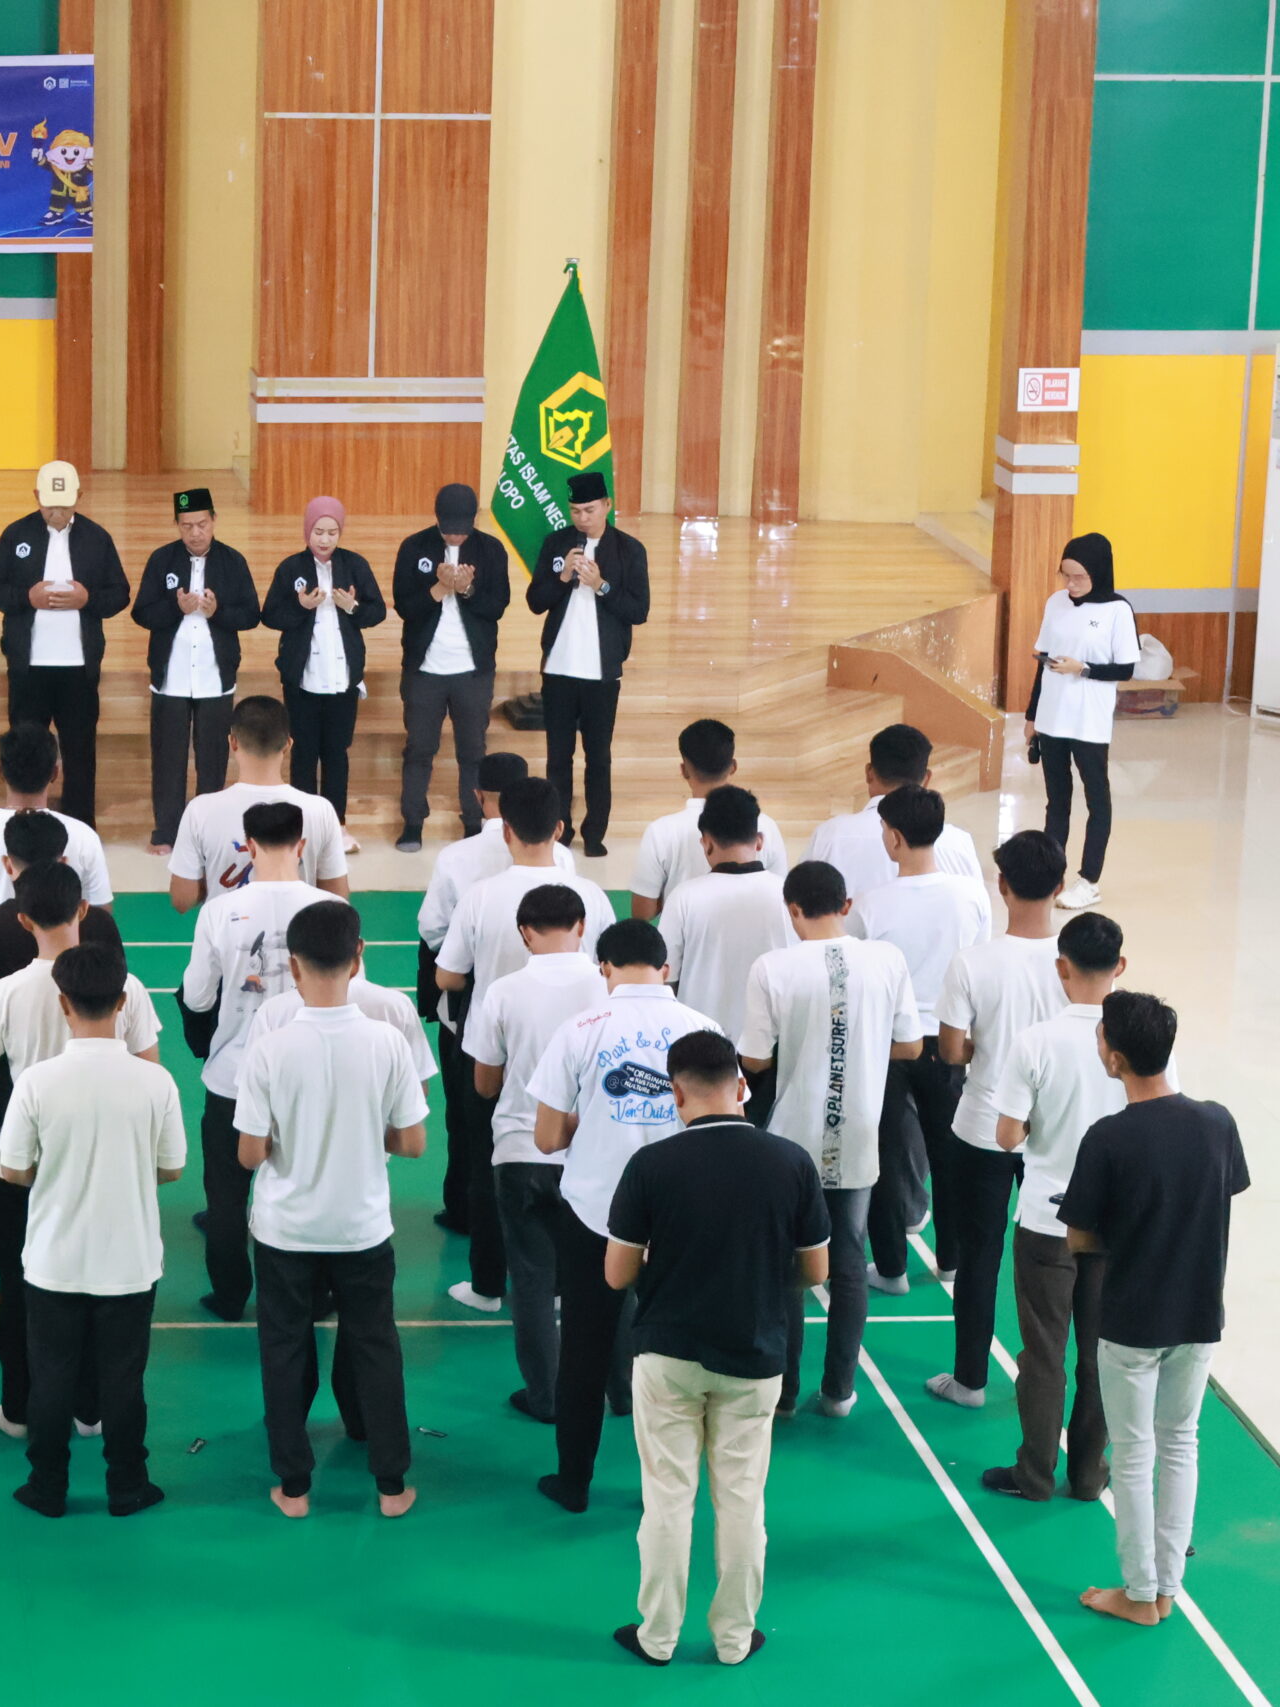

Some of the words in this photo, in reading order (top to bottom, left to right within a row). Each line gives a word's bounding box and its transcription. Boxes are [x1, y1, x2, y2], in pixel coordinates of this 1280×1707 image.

[518, 462, 551, 505] ISLAM
[597, 1036, 631, 1068] Part
[635, 1031, 651, 1048] &
[652, 1027, 672, 1052] S
[827, 1017, 848, 1113] PLANETSURF
[633, 1068, 673, 1090] ORIGINATO
[609, 1098, 637, 1121] Von
[636, 1100, 677, 1122] Dutch
